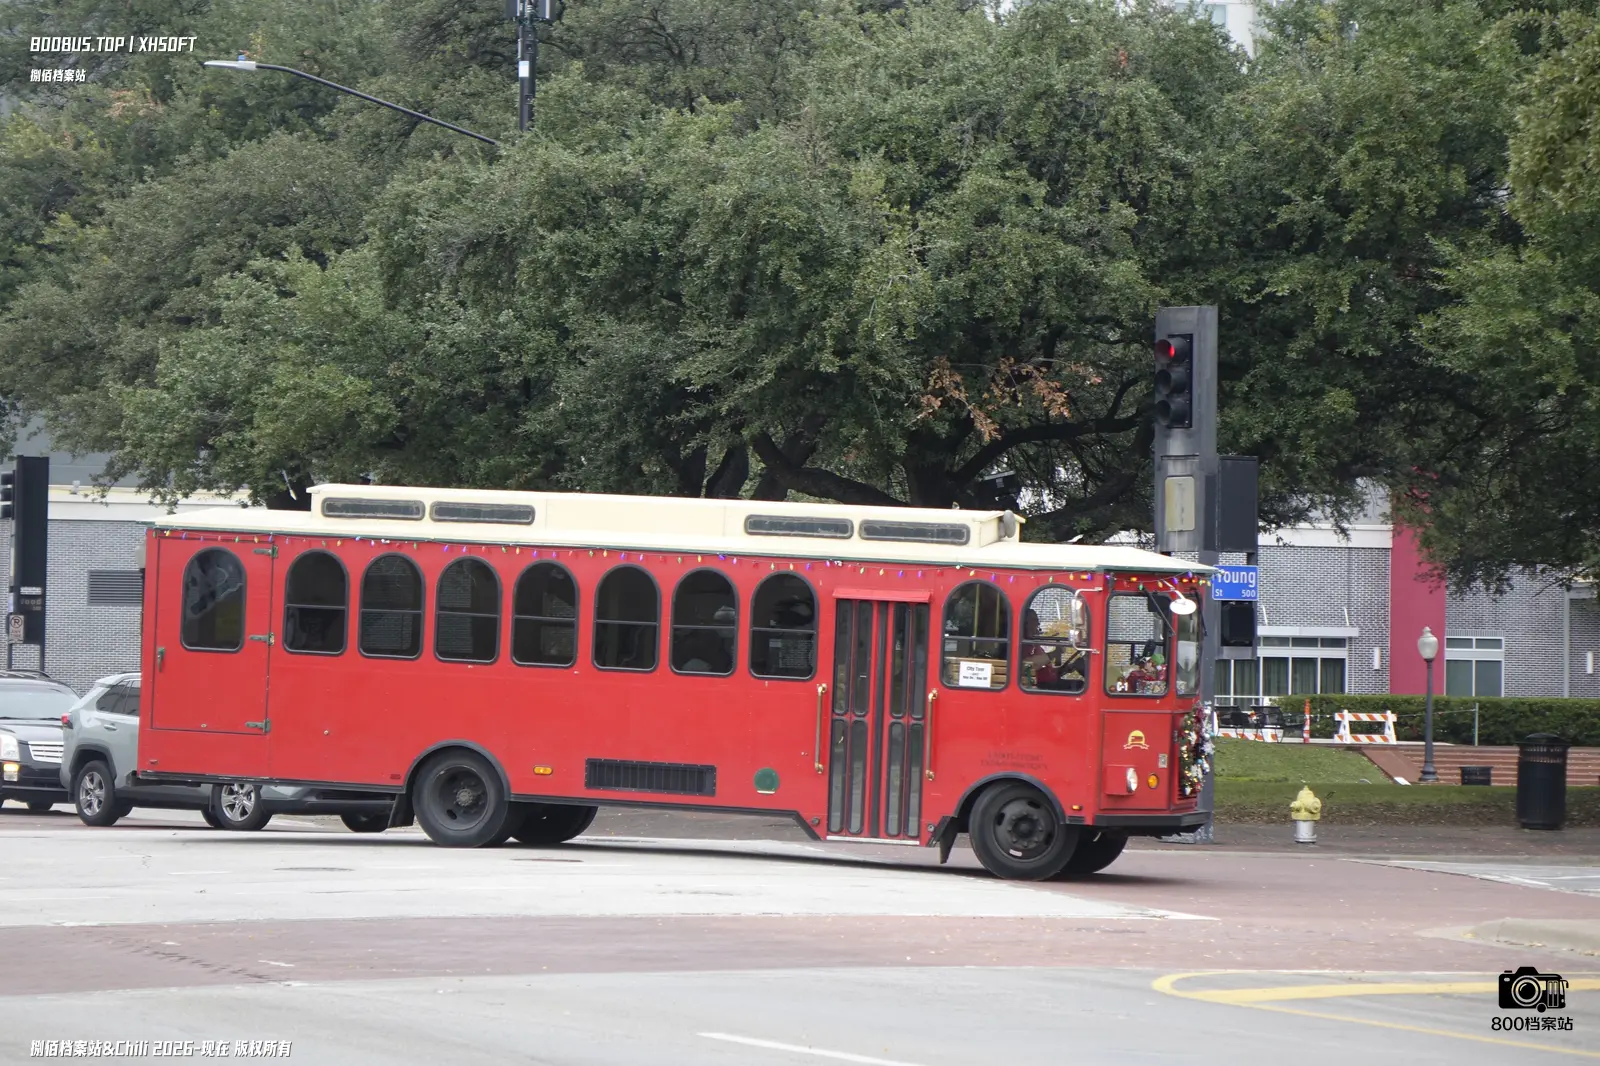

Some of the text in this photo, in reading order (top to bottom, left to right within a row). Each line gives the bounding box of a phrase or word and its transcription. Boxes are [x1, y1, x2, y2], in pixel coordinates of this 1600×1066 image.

[1215, 589, 1256, 598] St 500
[1117, 682, 1128, 691] C-1
